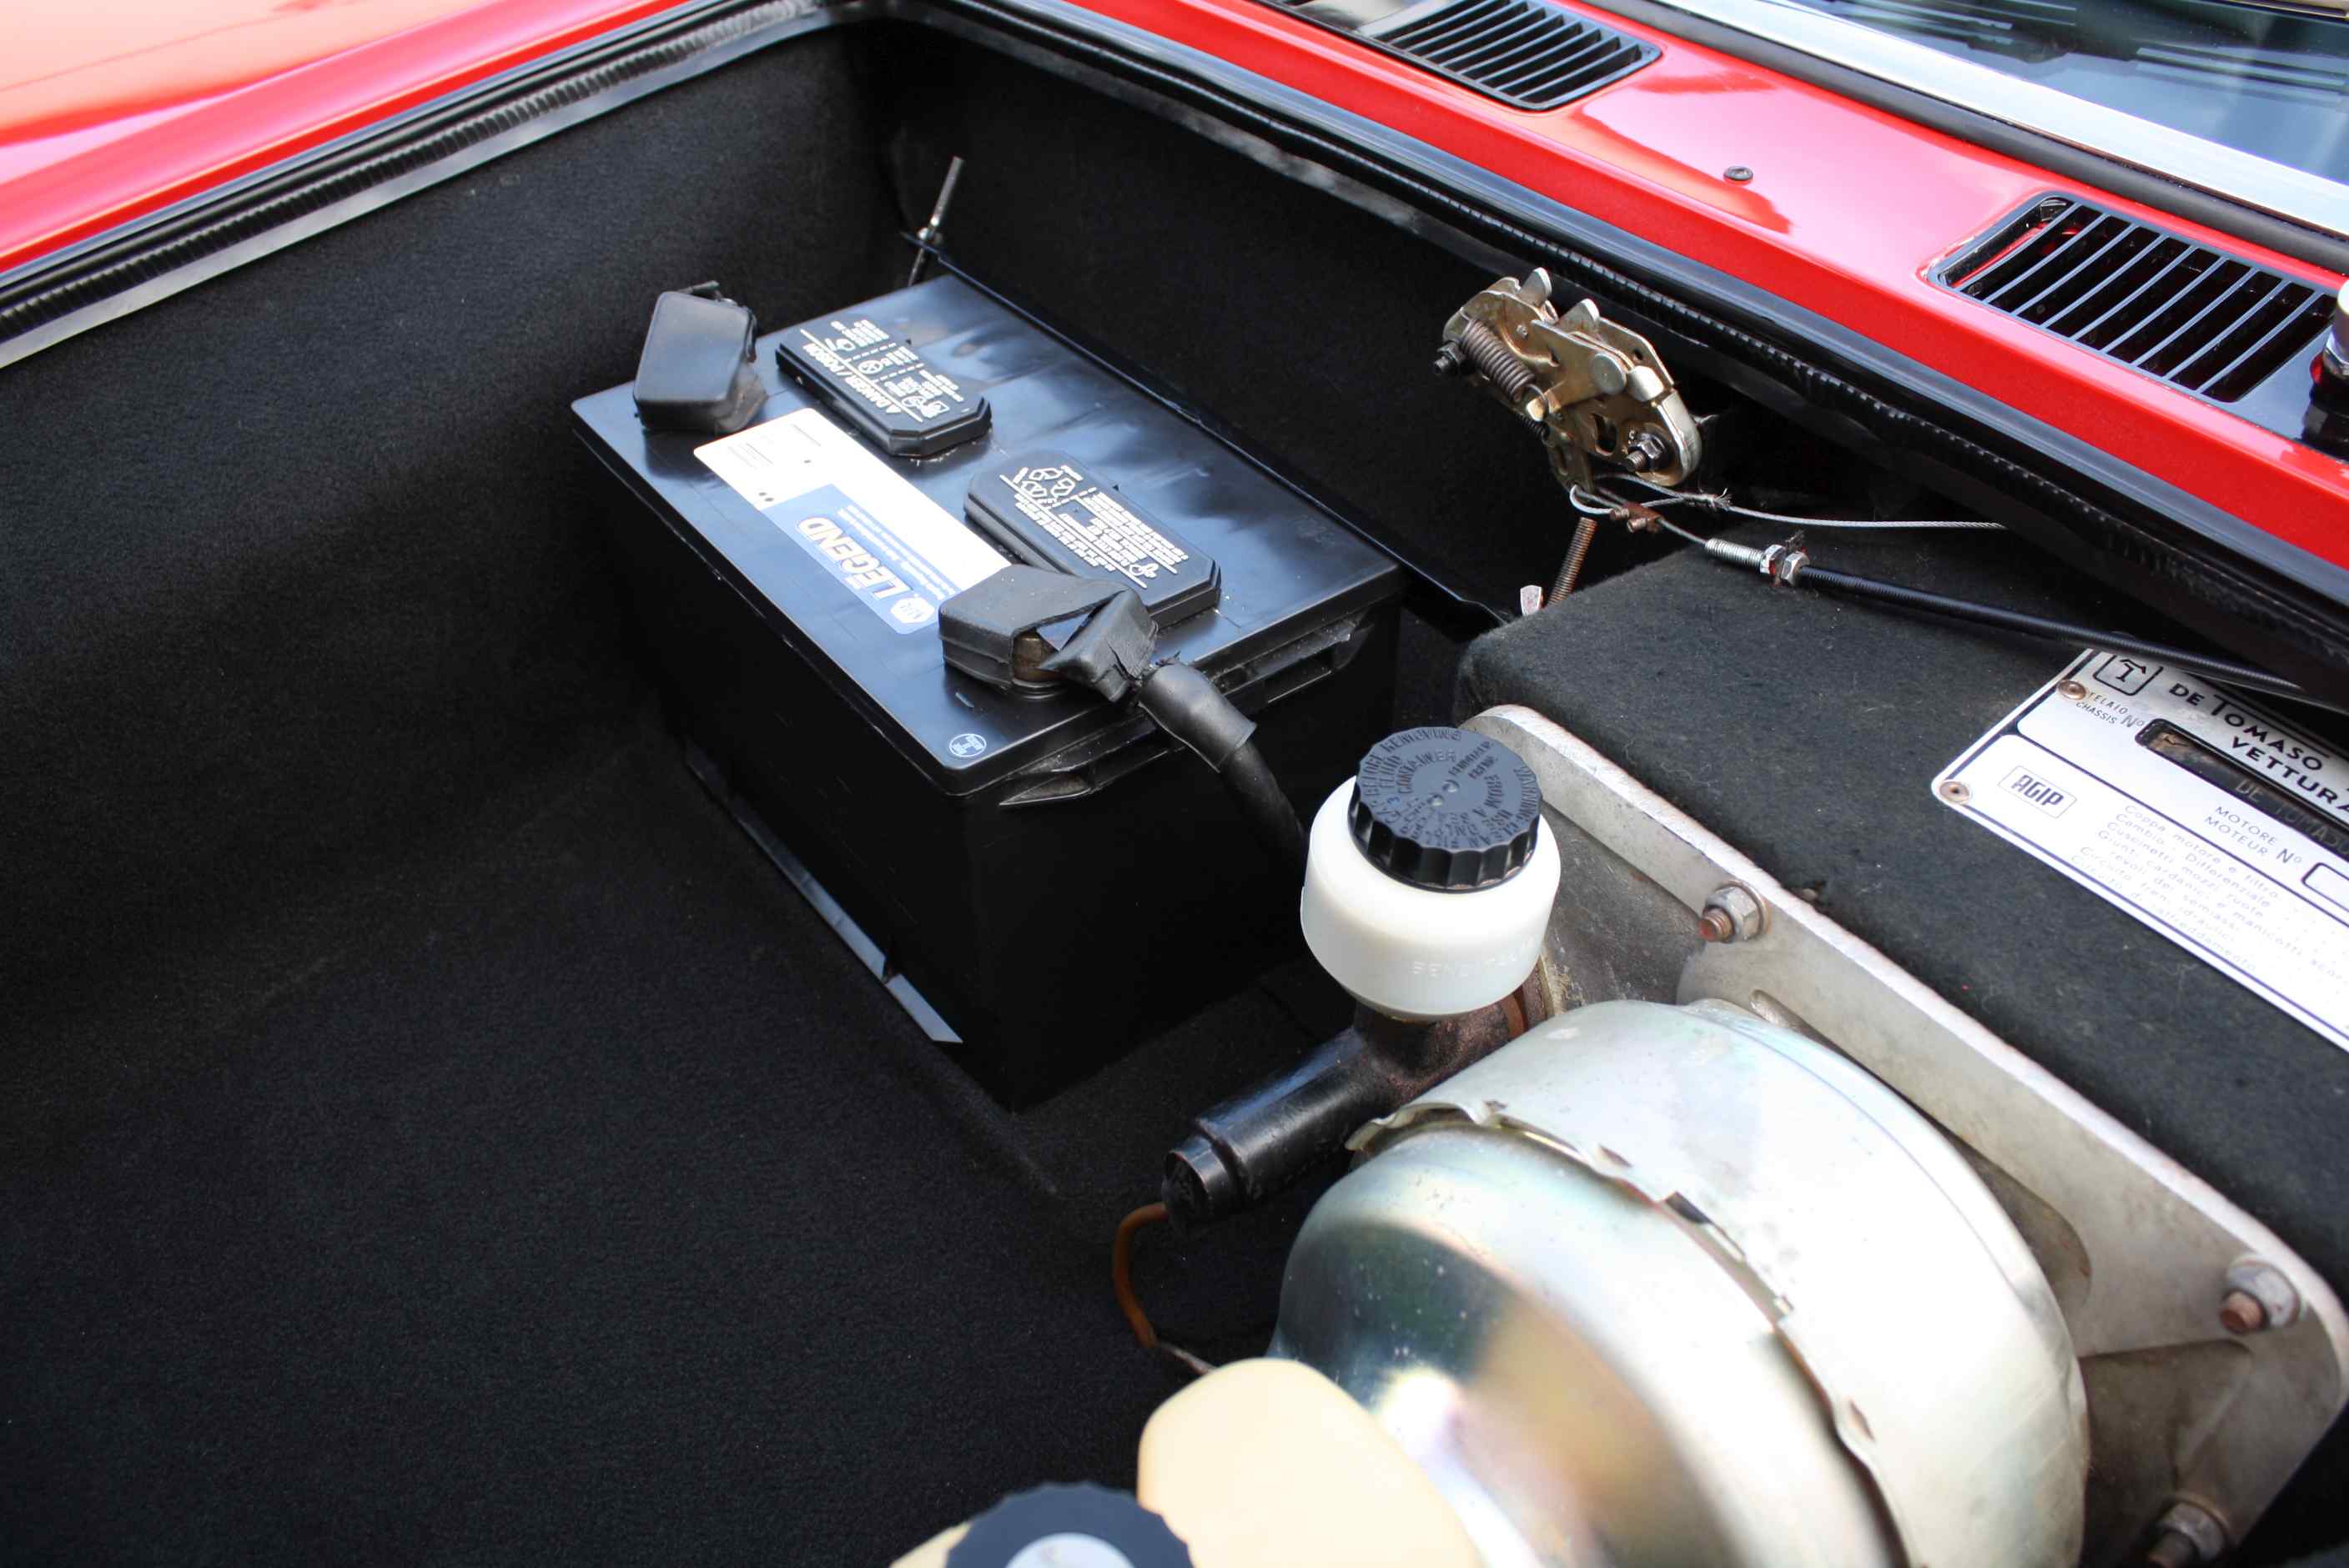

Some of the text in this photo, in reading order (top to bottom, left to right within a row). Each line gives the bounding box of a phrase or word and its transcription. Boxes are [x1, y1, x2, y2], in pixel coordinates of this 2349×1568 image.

[796, 515, 913, 601] LEGEND
[2075, 701, 2117, 725] CHASSIS
[2169, 682, 2329, 771] DE TOMASO
[1379, 728, 1462, 752] REMOVING
[1376, 754, 1403, 788] FLUID
[1389, 749, 1456, 794] CONTAINER
[2010, 774, 2065, 806] AGIP
[1483, 773, 1504, 810] FROM
[1512, 765, 1540, 823] WARNING
[2115, 813, 2165, 846] Cambio
[2125, 805, 2166, 833] Coppa
[2172, 834, 2221, 864] motore
[2204, 816, 2269, 857] MOTEUR
[2215, 806, 2277, 846] MOTORE
